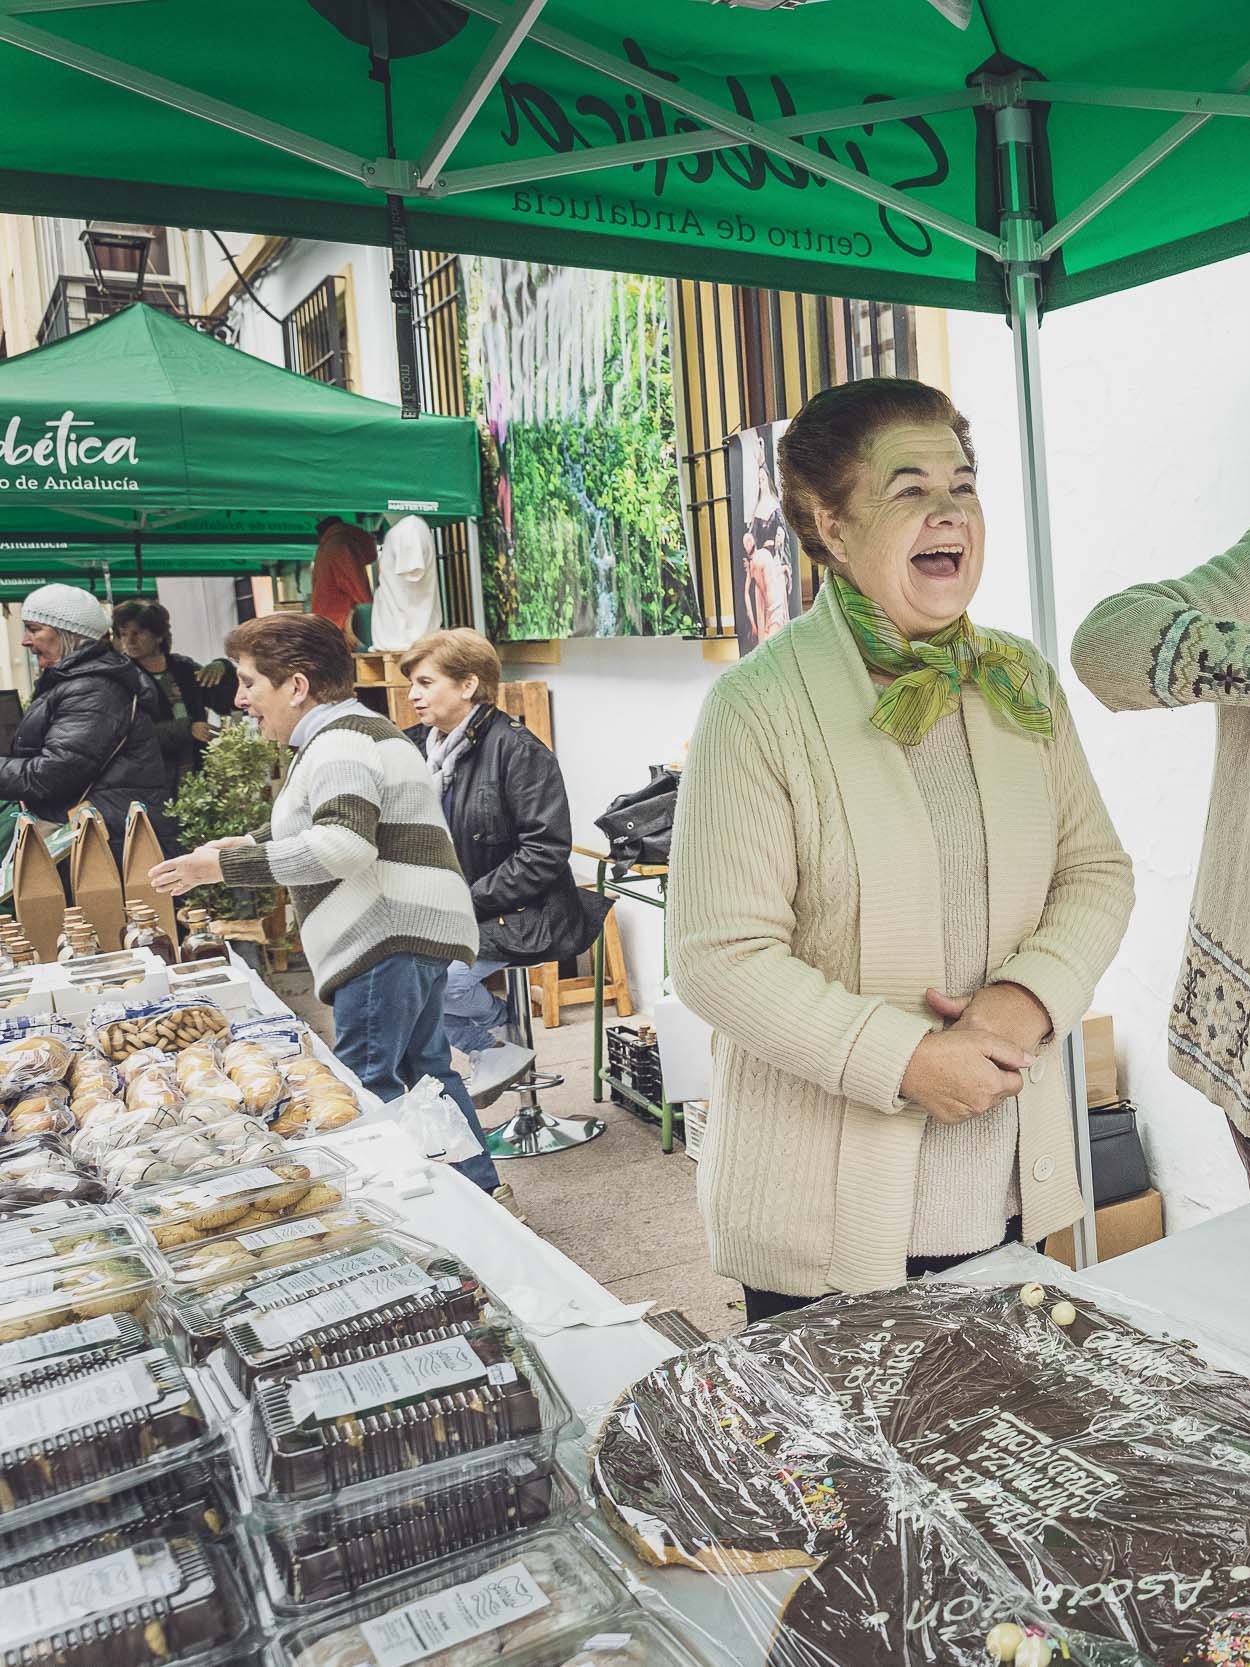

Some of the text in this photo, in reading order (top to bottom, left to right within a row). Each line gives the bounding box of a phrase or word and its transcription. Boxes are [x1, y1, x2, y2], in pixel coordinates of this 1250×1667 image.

[0, 410, 139, 474] bética
[15, 475, 38, 489] de
[44, 476, 139, 491] Andalucía
